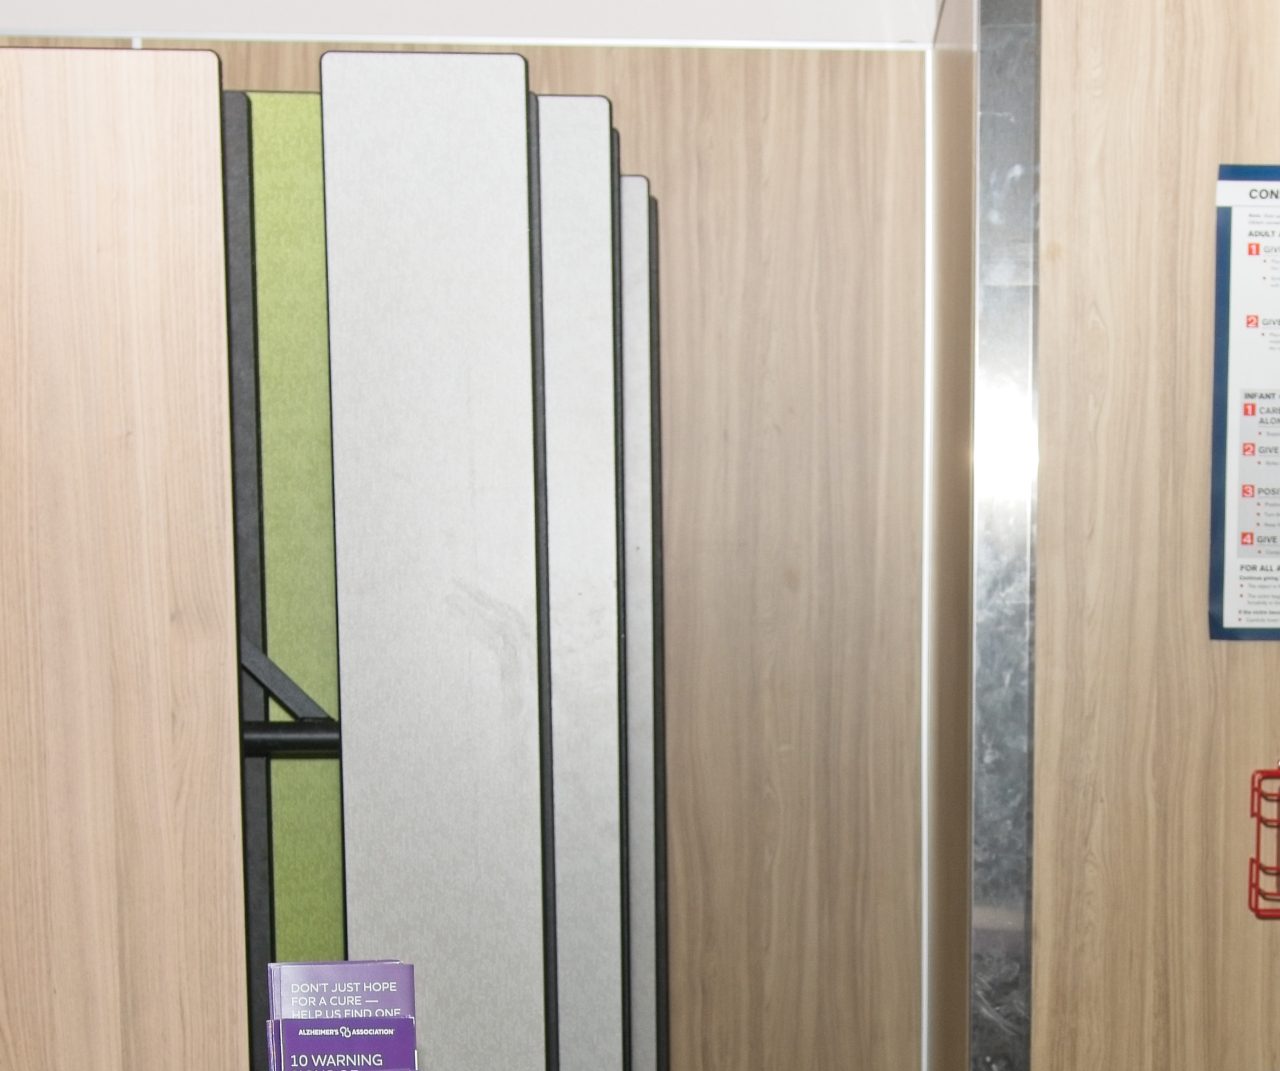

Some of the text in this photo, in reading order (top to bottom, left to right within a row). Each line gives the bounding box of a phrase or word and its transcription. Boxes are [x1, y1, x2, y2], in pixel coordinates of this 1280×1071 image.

[1248, 316, 1258, 327] 2
[1244, 392, 1276, 400] INFANT
[1244, 443, 1255, 456] 2
[1258, 446, 1279, 454] GIVE
[1243, 485, 1254, 497] 3
[1242, 533, 1252, 544] 4
[1240, 564, 1257, 572] FOR
[1259, 564, 1274, 572] ALL
[290, 982, 397, 993] DON'T JUST HOPE
[291, 996, 362, 1006] FOR A CURE
[292, 1008, 401, 1018] HELP US FIND ONE
[298, 1028, 394, 1036] ALZHEIMER'S ASSOCIATION
[290, 1054, 384, 1067] 10 WARNING
